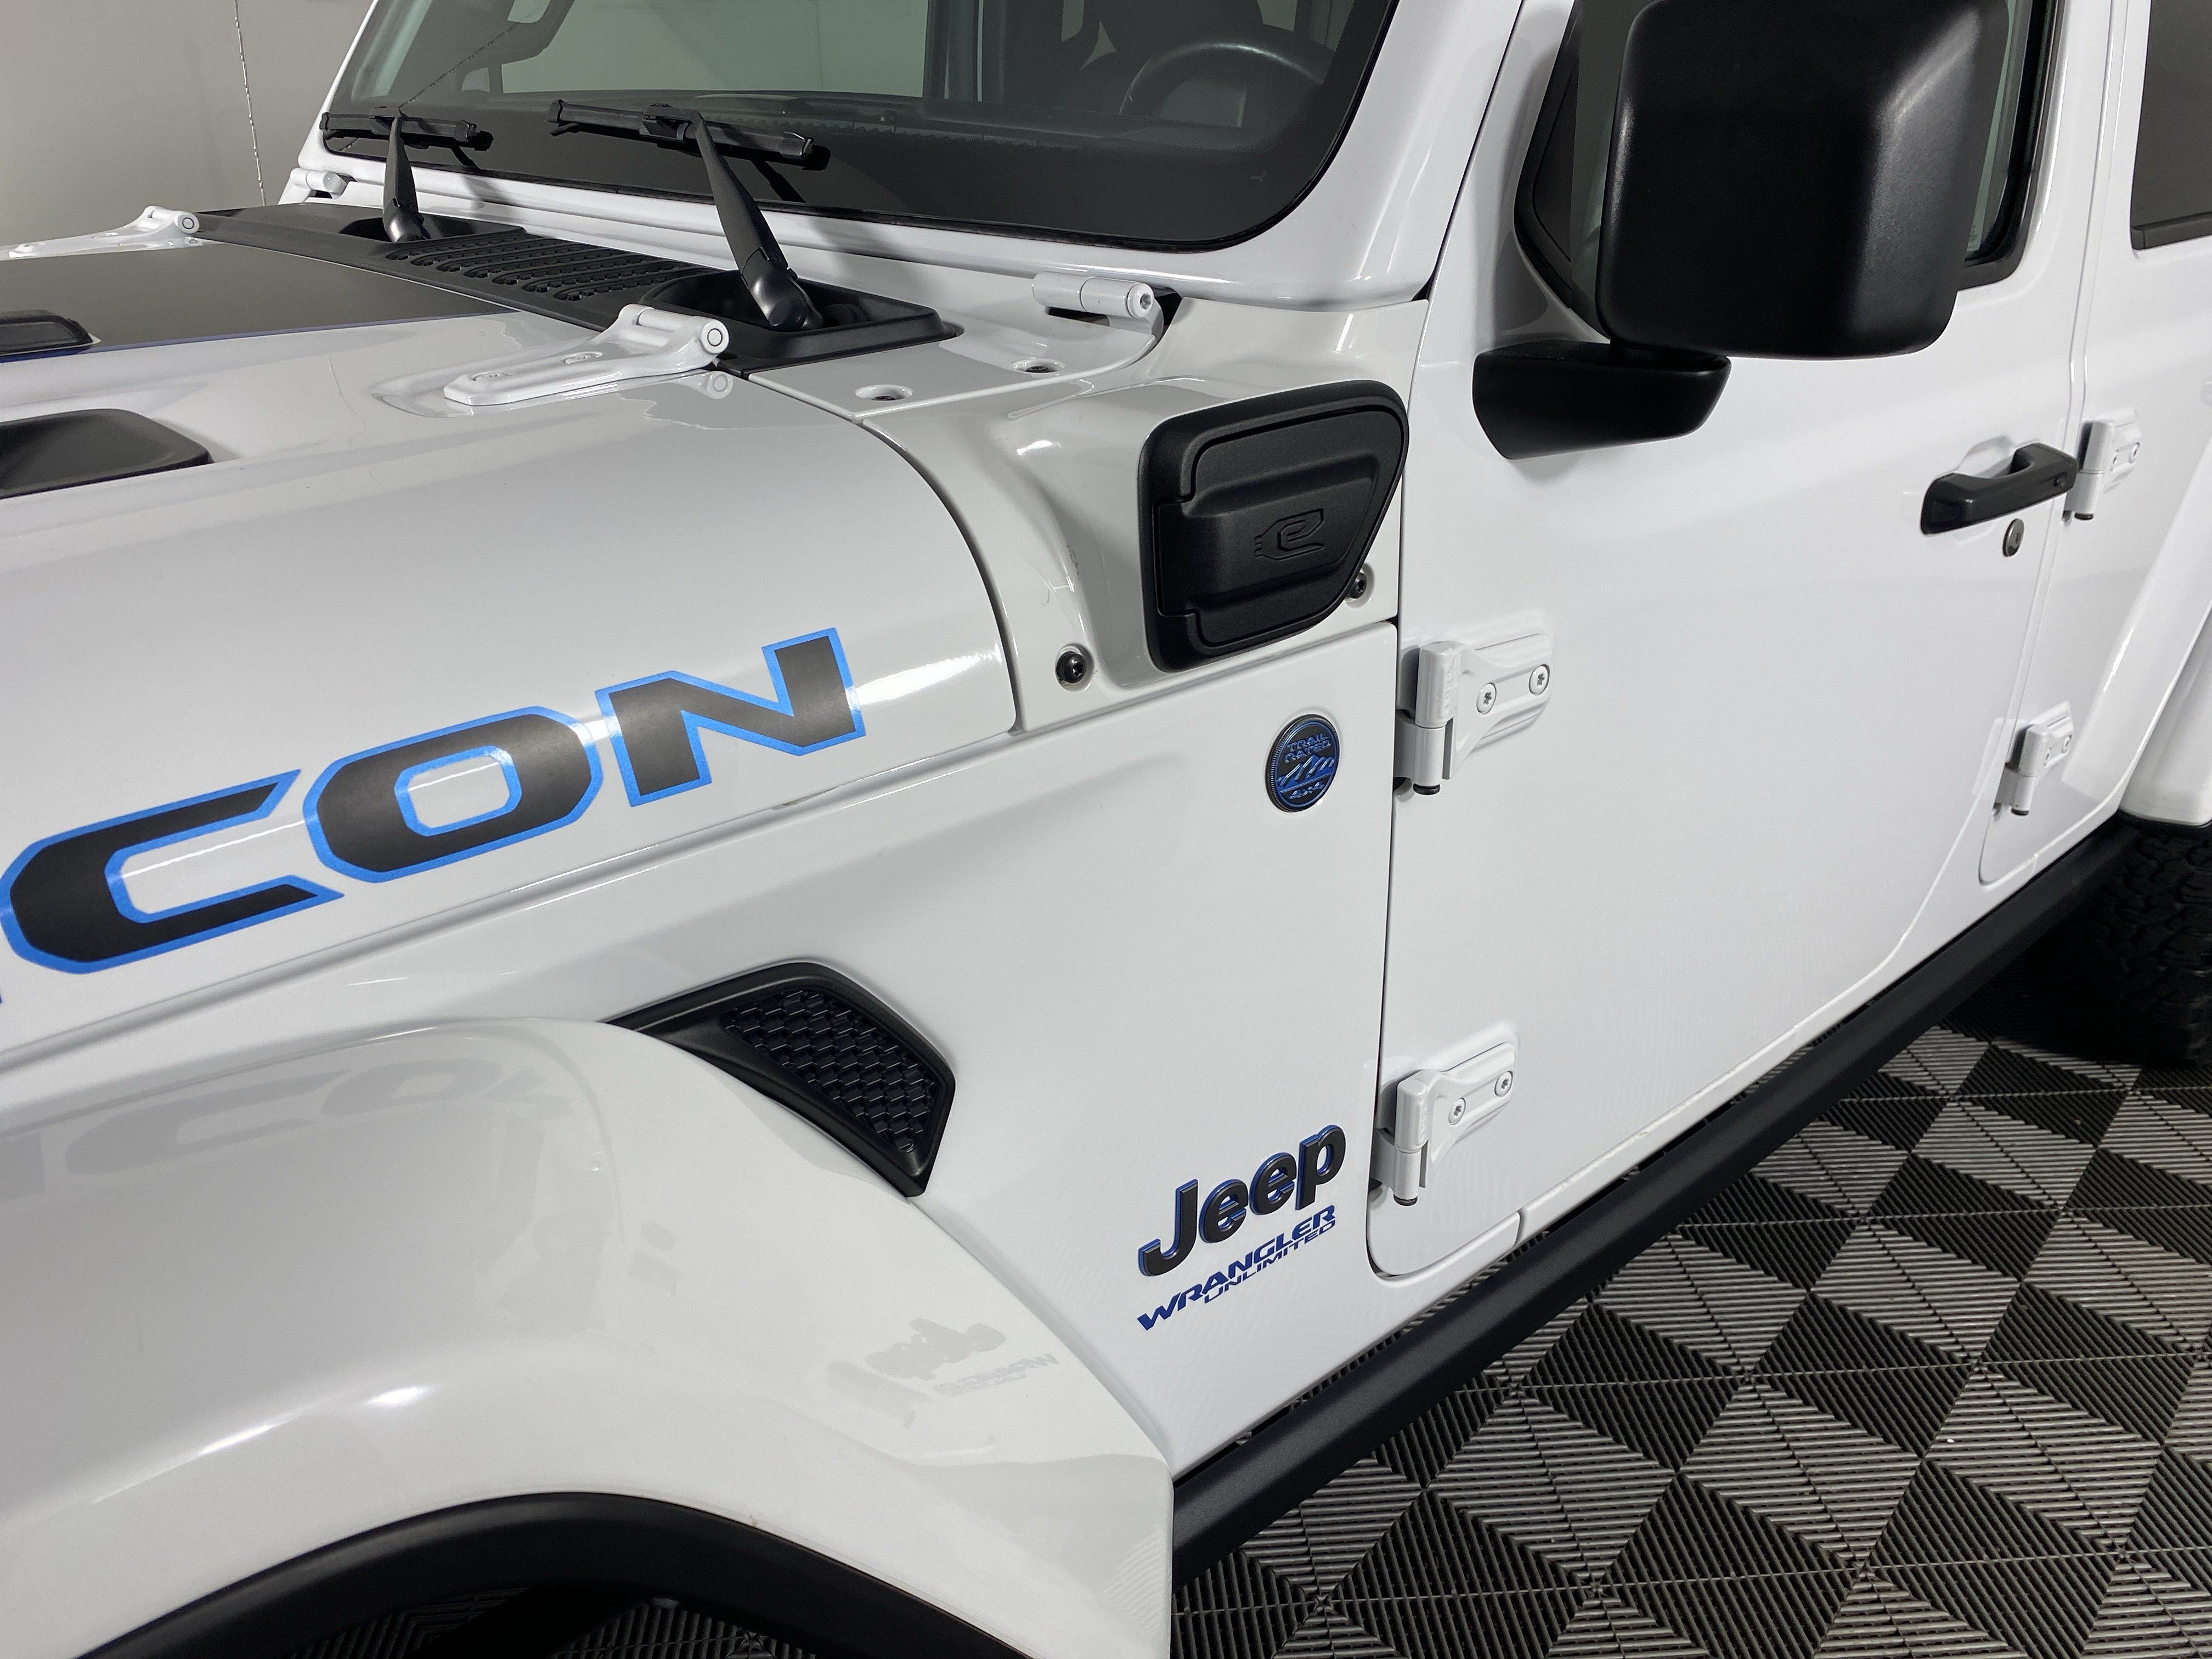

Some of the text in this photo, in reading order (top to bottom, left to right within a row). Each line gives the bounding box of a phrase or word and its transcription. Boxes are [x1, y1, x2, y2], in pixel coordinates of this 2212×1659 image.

[1284, 740, 1331, 763] RATED
[1286, 732, 1329, 753] TRAIL
[1138, 1124, 1346, 1277] Jeep
[1137, 1205, 1335, 1330] WRANGLER
[1204, 1220, 1335, 1304] UNLIMITED
